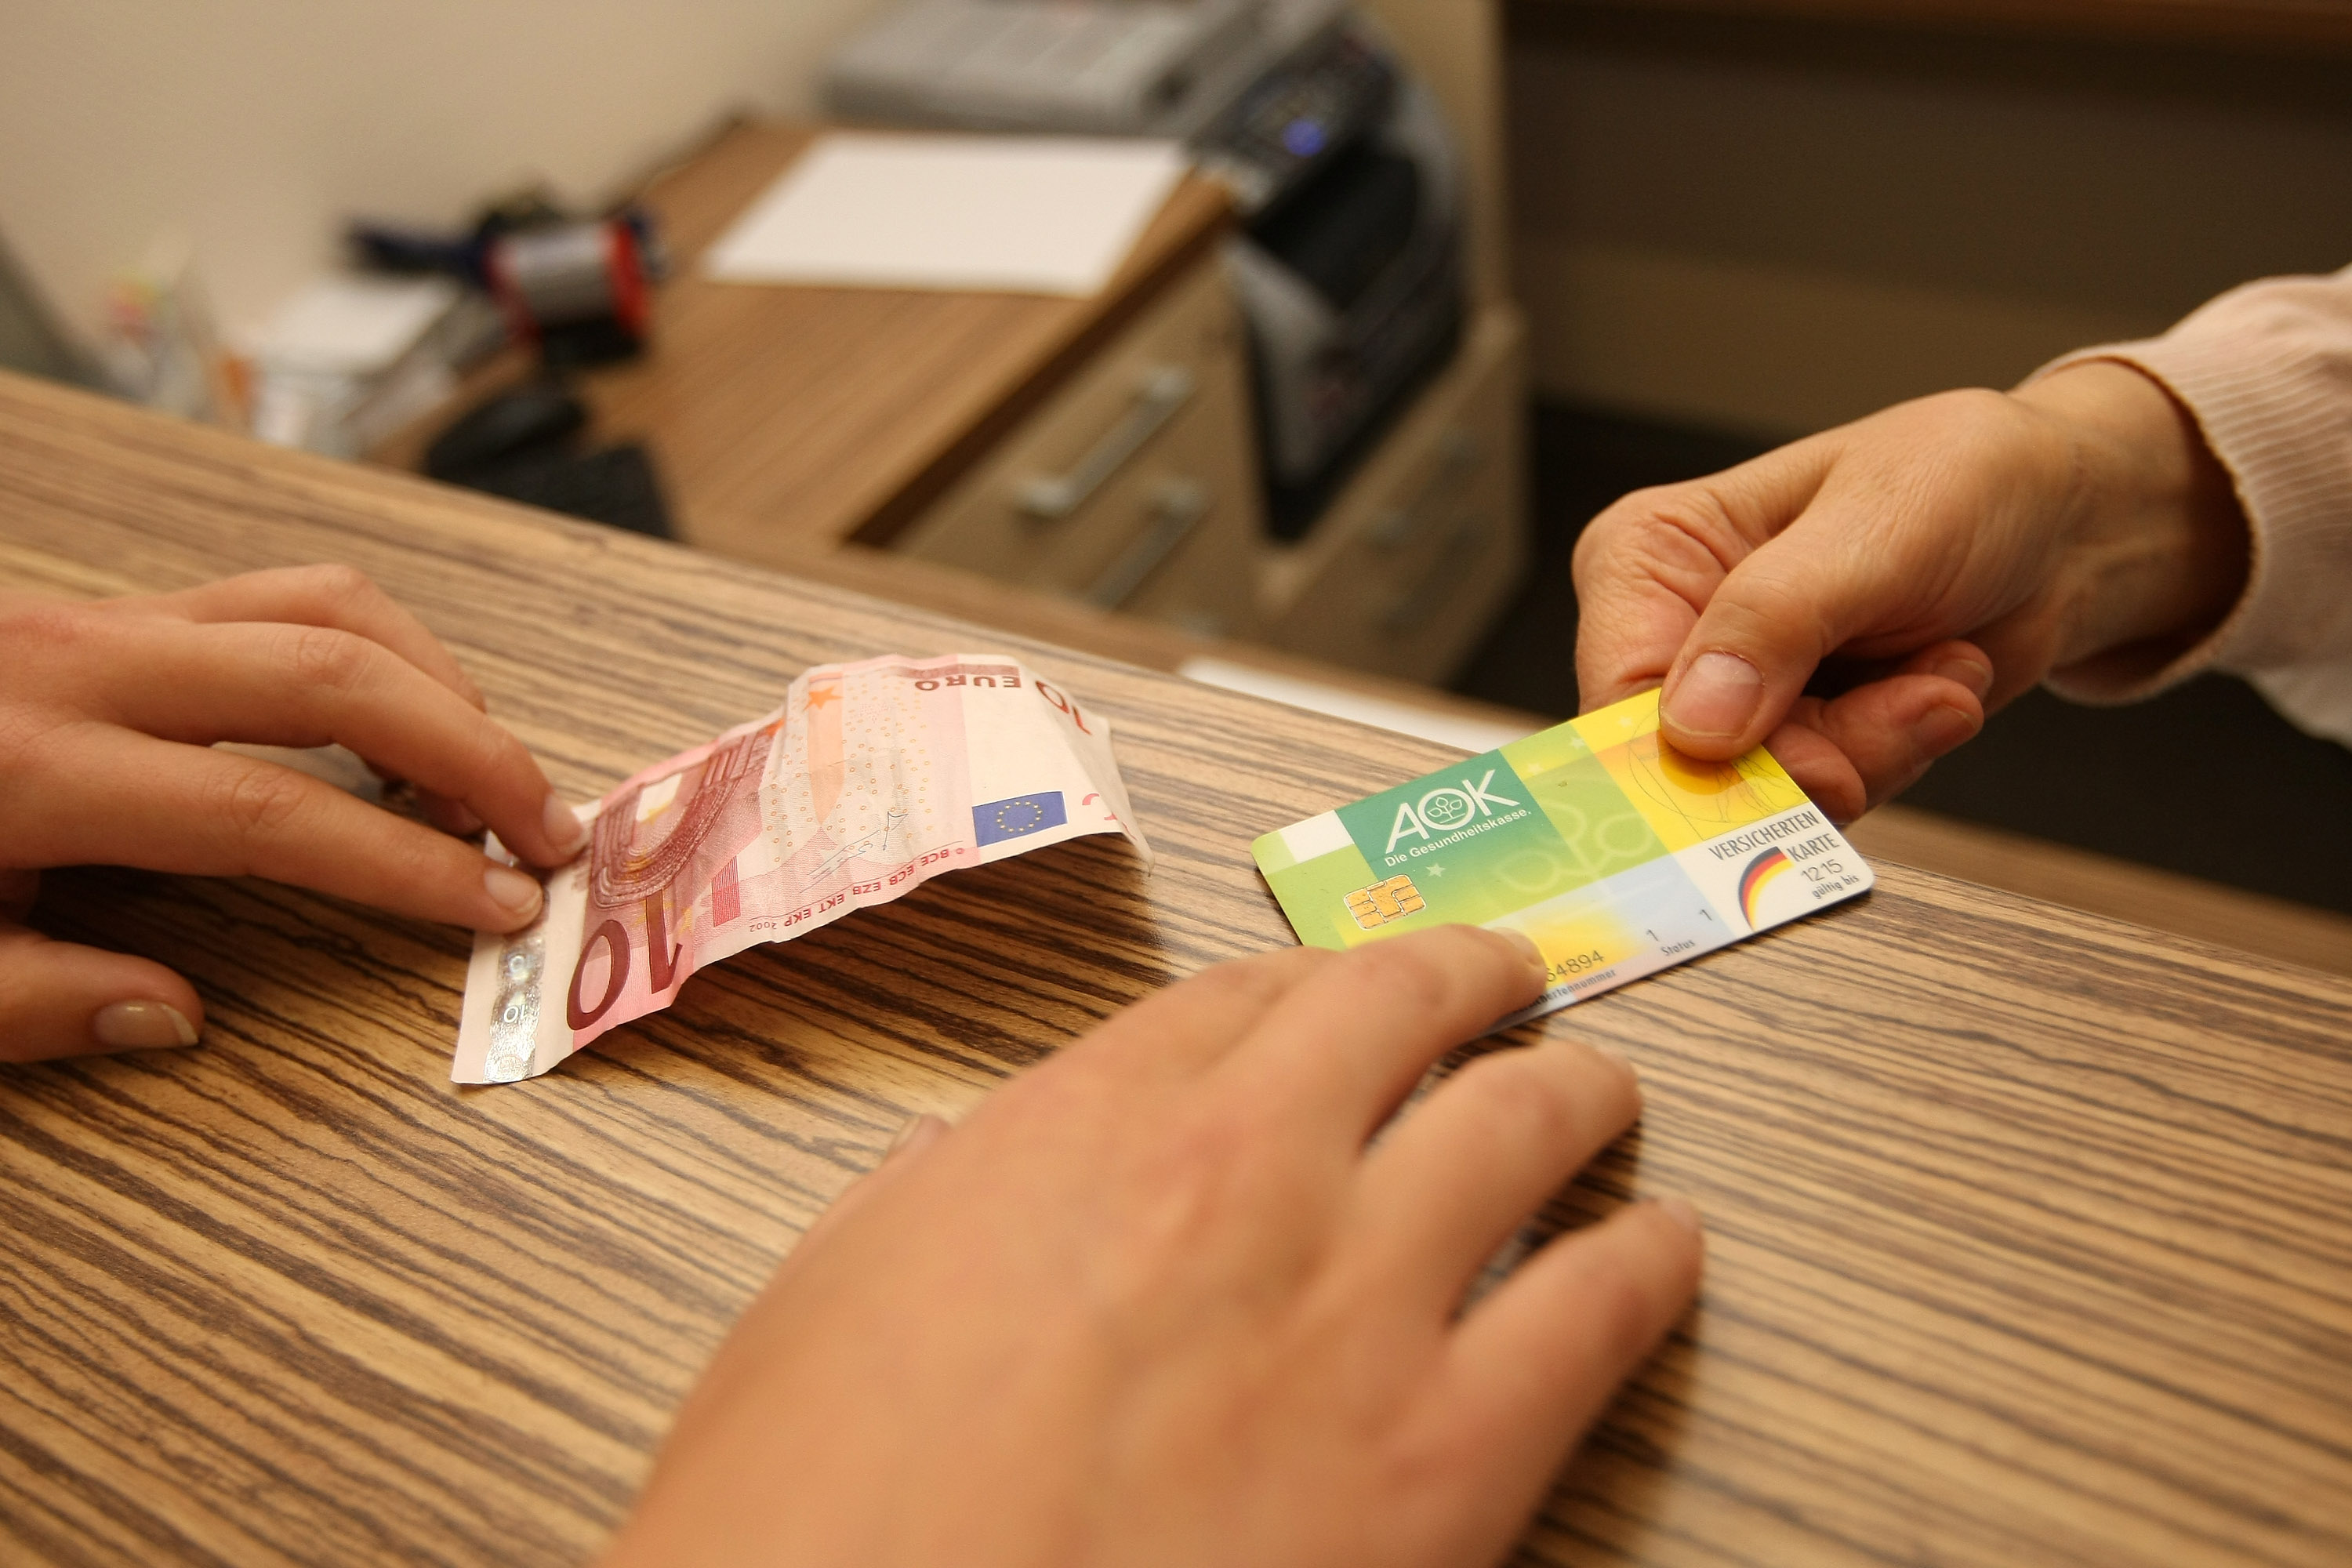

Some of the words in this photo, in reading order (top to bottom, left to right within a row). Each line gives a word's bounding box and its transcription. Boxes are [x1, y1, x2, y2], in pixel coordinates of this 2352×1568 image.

[914, 674, 1022, 691] EURO
[1385, 769, 1520, 855] AOK
[1383, 851, 1408, 867] Die
[1409, 808, 1532, 858] Gesundheitskasse.
[1708, 810, 1820, 861] VERSICHERTEN
[1786, 833, 1841, 862] KARTE
[920, 848, 950, 866] BCE
[889, 864, 916, 886] ECB
[1801, 858, 1843, 883] 1215
[852, 881, 882, 895] EZB
[1812, 880, 1843, 899] gültig
[1844, 874, 1860, 886] bis
[818, 893, 846, 913] EKT
[749, 921, 778, 933] 2002
[784, 909, 812, 927] EKP
[566, 887, 684, 1031] 10
[1544, 949, 1605, 982] 64894
[1534, 969, 1617, 1005] hertennummer
[1660, 939, 1696, 957] Status
[503, 1004, 529, 1023] 10
